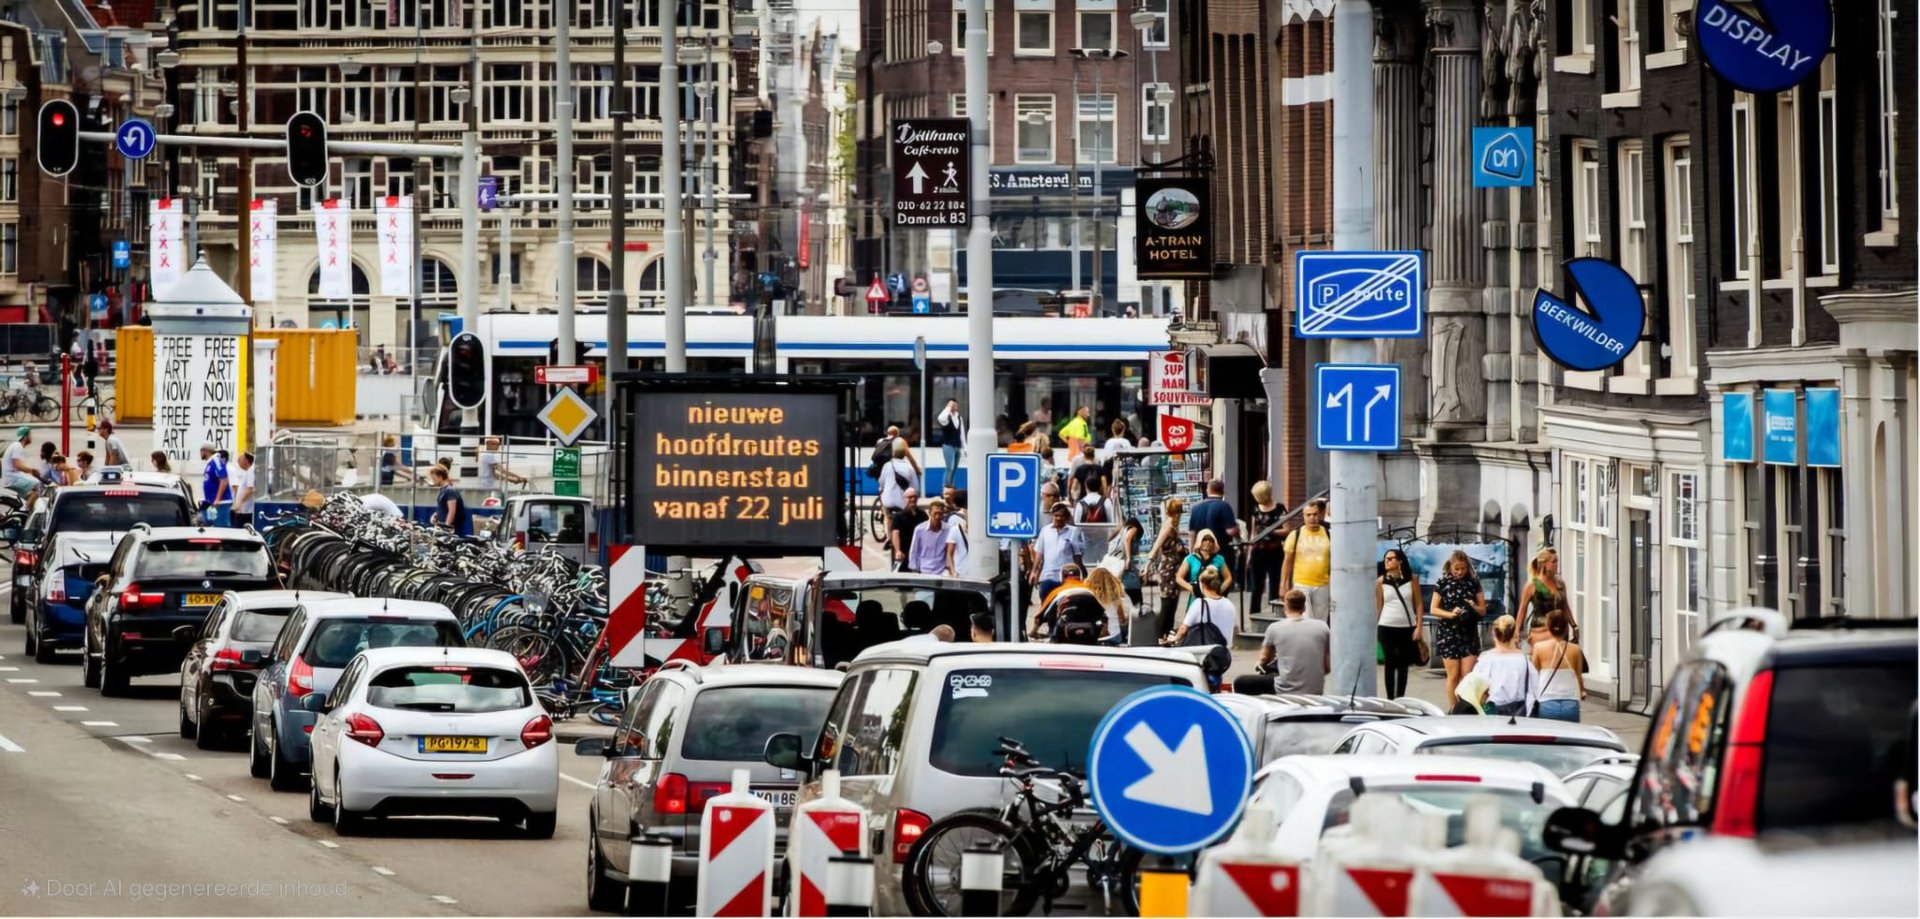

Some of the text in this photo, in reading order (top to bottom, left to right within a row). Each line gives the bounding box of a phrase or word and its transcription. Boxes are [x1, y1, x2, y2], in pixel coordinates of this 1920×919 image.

[1703, 4, 1812, 70] DISPLAY
[950, 212, 966, 224] 83
[1145, 235, 1201, 246] A-TRAIN
[1150, 249, 1198, 260] HOTEL
[1323, 287, 1334, 303] P
[1539, 300, 1625, 355] BEEKWILDER
[163, 337, 192, 358] FREE
[205, 337, 236, 358] FREE
[164, 359, 190, 380] ART
[206, 359, 234, 380] ART
[163, 381, 191, 401] NOW
[203, 381, 235, 401] NOW
[161, 406, 191, 426] FREE
[203, 406, 234, 427] FREE
[688, 401, 784, 424] nieuwe
[163, 429, 188, 449] ART
[206, 429, 232, 450] ART
[656, 432, 820, 456] hoofdroutes
[656, 463, 809, 488] binnenstad
[999, 461, 1027, 502] P
[653, 496, 824, 526] vanaf 22 juli
